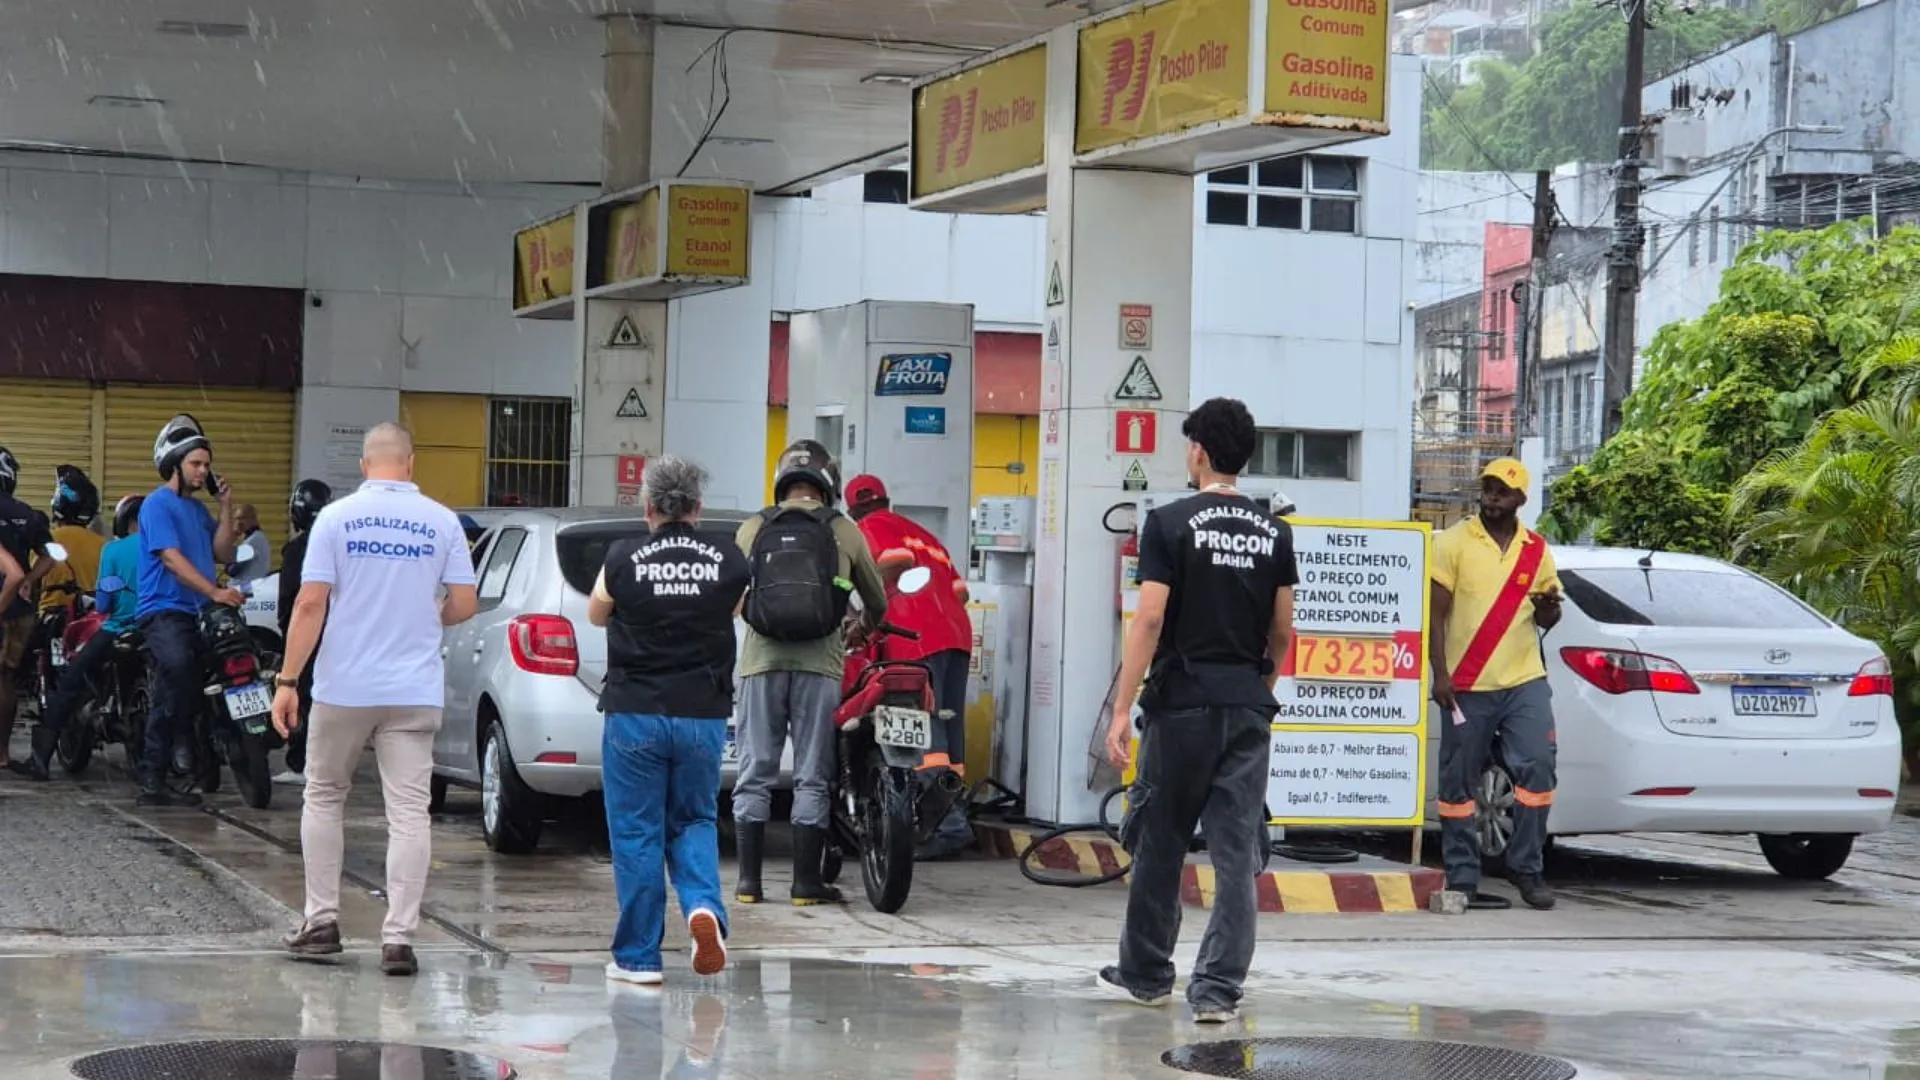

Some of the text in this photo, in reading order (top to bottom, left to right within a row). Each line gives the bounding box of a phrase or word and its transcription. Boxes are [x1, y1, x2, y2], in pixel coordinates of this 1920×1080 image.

[1300, 15, 1365, 37] Comum
[1160, 39, 1228, 84] Posto Pilar
[1282, 51, 1374, 81] Gasolina
[1288, 80, 1368, 104] Aditivada
[981, 97, 1036, 137] Posto Pilar
[677, 196, 739, 213] Gasolina
[688, 215, 730, 227] Comum
[685, 238, 732, 252] Etanol
[686, 255, 730, 267] Comum
[884, 371, 945, 385] FROTA
[344, 516, 436, 539] FISCALIZAÇÃO
[1188, 506, 1278, 537] FISCALIZAÇÃO
[1194, 530, 1275, 556] PROCON
[1327, 533, 1368, 547] NESTE
[347, 541, 420, 558] PROCON
[630, 536, 724, 563] FISCALIZAÇÃO
[1212, 552, 1254, 569] BAHIA
[1295, 551, 1411, 571] TABELECIMENTO,
[635, 562, 719, 582] PROCON
[1306, 571, 1387, 587] O PREÇO DO
[653, 583, 700, 596] BAHIA
[1294, 588, 1399, 605] ETANOL COMUM
[260, 601, 276, 611] 156
[1391, 613, 1401, 624] A
[1297, 685, 1387, 702] DO PREÇO DA
[1279, 704, 1406, 719] GASOLINA COMUM.
[883, 717, 923, 731] NTM
[882, 730, 925, 746] 4280
[1274, 743, 1304, 754] Abaixo
[1307, 744, 1319, 754] de
[1320, 744, 1335, 756] 0,7
[1344, 744, 1373, 755] Melhor
[1376, 744, 1408, 756] Etanol;
[1270, 768, 1297, 779] Acima
[1300, 768, 1311, 779] de
[1313, 768, 1327, 780] 0,7
[1336, 768, 1366, 779] Melhor
[1369, 768, 1411, 781] Gasolina;
[1288, 792, 1311, 804] Igual
[1313, 792, 1328, 804] 0,7
[1337, 792, 1391, 804] Indiferente.
